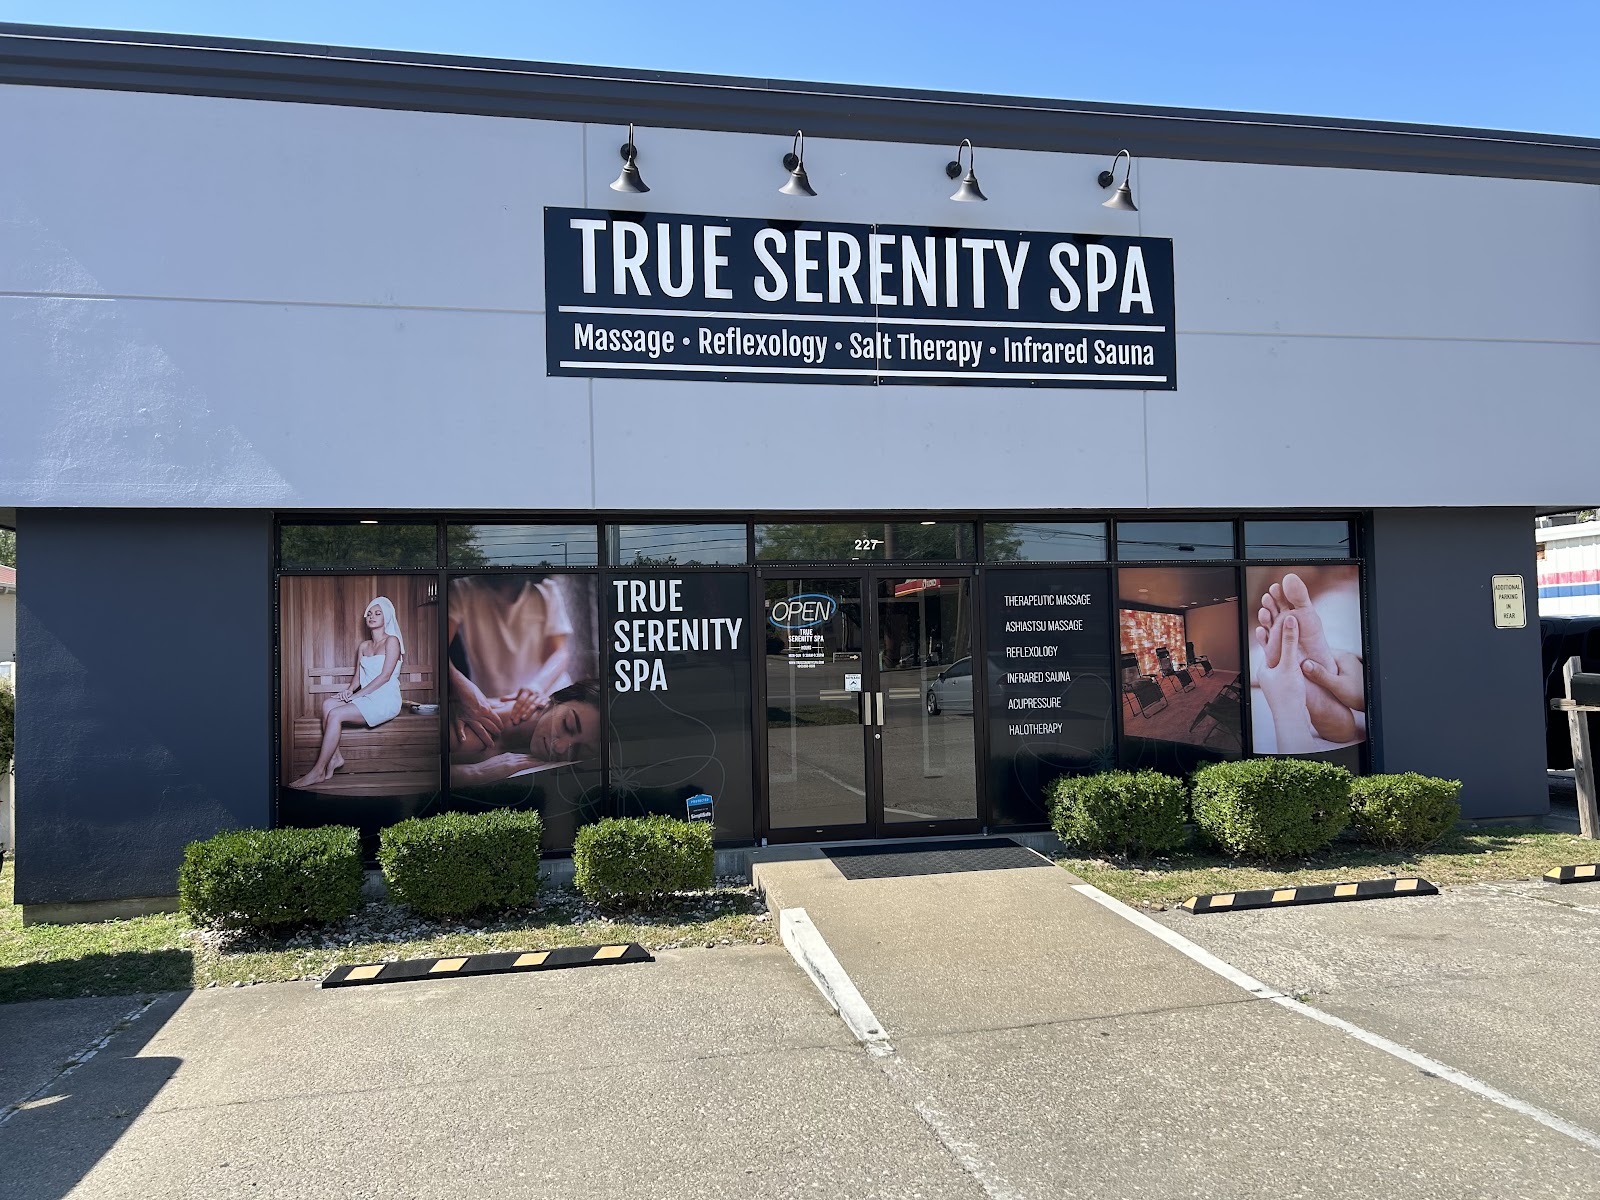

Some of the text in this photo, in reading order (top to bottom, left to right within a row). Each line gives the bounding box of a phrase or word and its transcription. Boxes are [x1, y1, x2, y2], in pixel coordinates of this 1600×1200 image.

[570, 218, 1154, 314] TRUE SERENITY SPA
[574, 323, 1154, 367] Massage Reflexology Salt Therapy Infrared Sauna
[854, 539, 879, 550] 227
[612, 579, 683, 613] TRUE
[1004, 594, 1091, 607] THERAPEUTIC MASSAGE
[772, 601, 830, 621] OPEN
[799, 628, 813, 636] TRUE
[1005, 619, 1083, 632] ASHIASTSU MASSAGE
[613, 617, 742, 653] SERENITY
[788, 635, 813, 643] SERENITY
[1006, 645, 1058, 658] REFLEXOLOGY
[614, 658, 668, 692] SPA
[1007, 671, 1071, 684] INFRARED SAUNA
[1008, 697, 1061, 709] ACUPRESSURE
[1009, 723, 1063, 735] HALOTHERAPY
